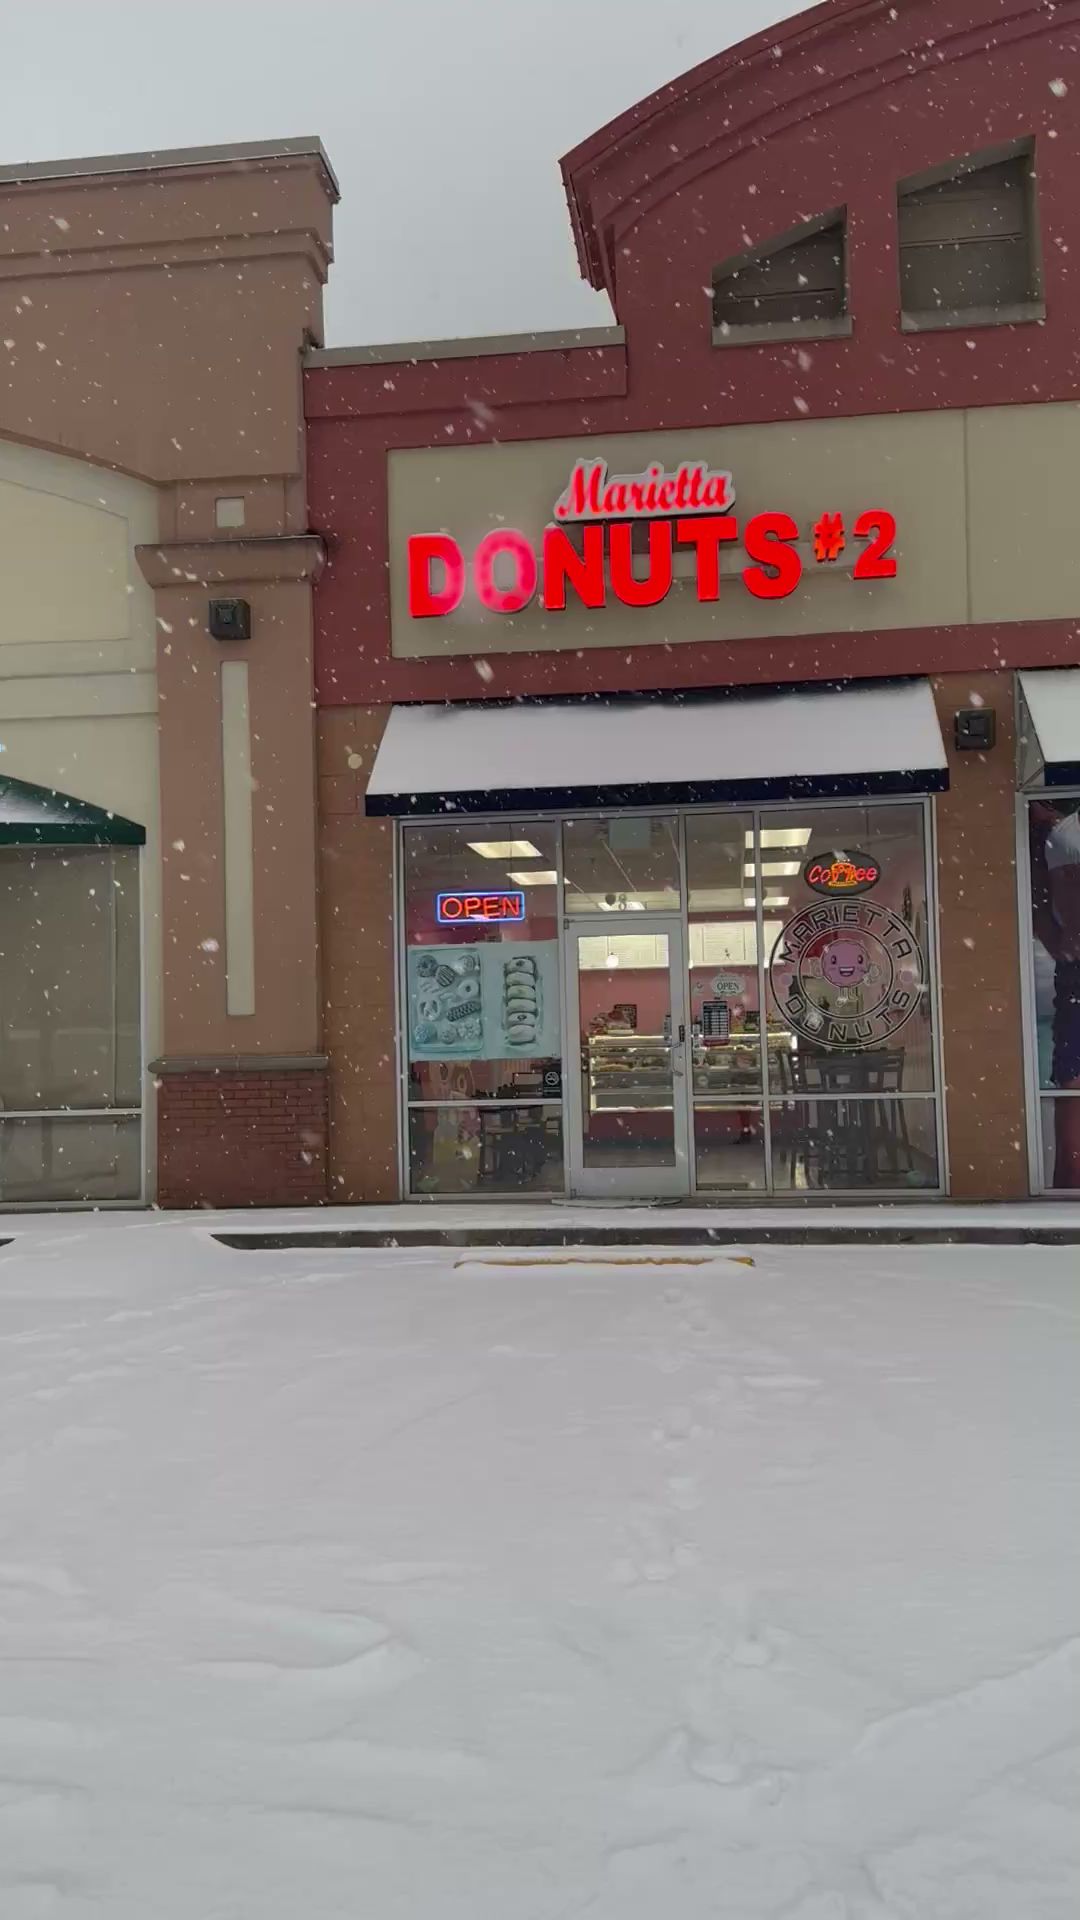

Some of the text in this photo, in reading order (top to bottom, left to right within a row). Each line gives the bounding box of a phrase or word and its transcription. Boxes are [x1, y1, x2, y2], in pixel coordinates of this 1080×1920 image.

[556, 464, 730, 517] Marietta
[408, 512, 802, 617] DONUTS
[441, 897, 520, 918] OPEN
[779, 905, 914, 963] MARIETTA
[716, 982, 740, 991] OPEN
[785, 989, 909, 1040] DONUTS
